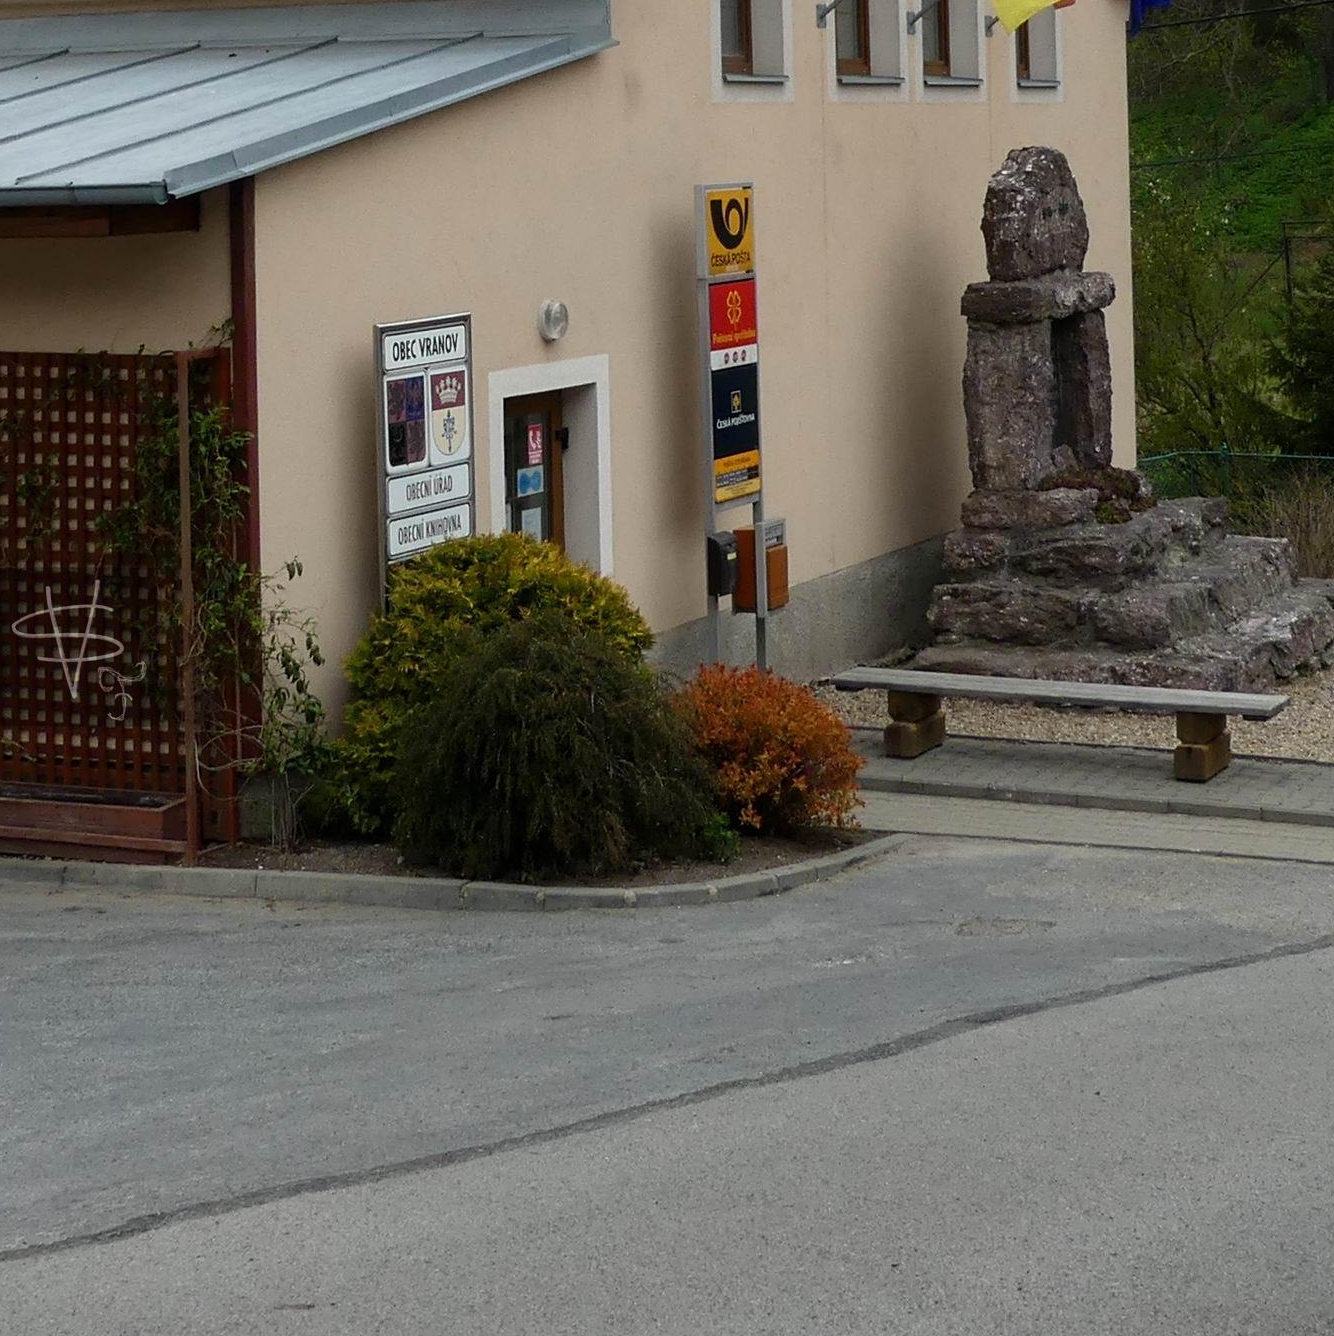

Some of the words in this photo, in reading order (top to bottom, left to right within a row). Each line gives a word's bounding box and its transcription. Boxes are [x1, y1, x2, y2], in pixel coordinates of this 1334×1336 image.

[392, 339, 417, 362] OBEC
[419, 333, 459, 358] VRANOV
[406, 475, 433, 501] OBECNÍ
[434, 472, 453, 495] ÚŘAD
[398, 518, 425, 545] OBECNÍ
